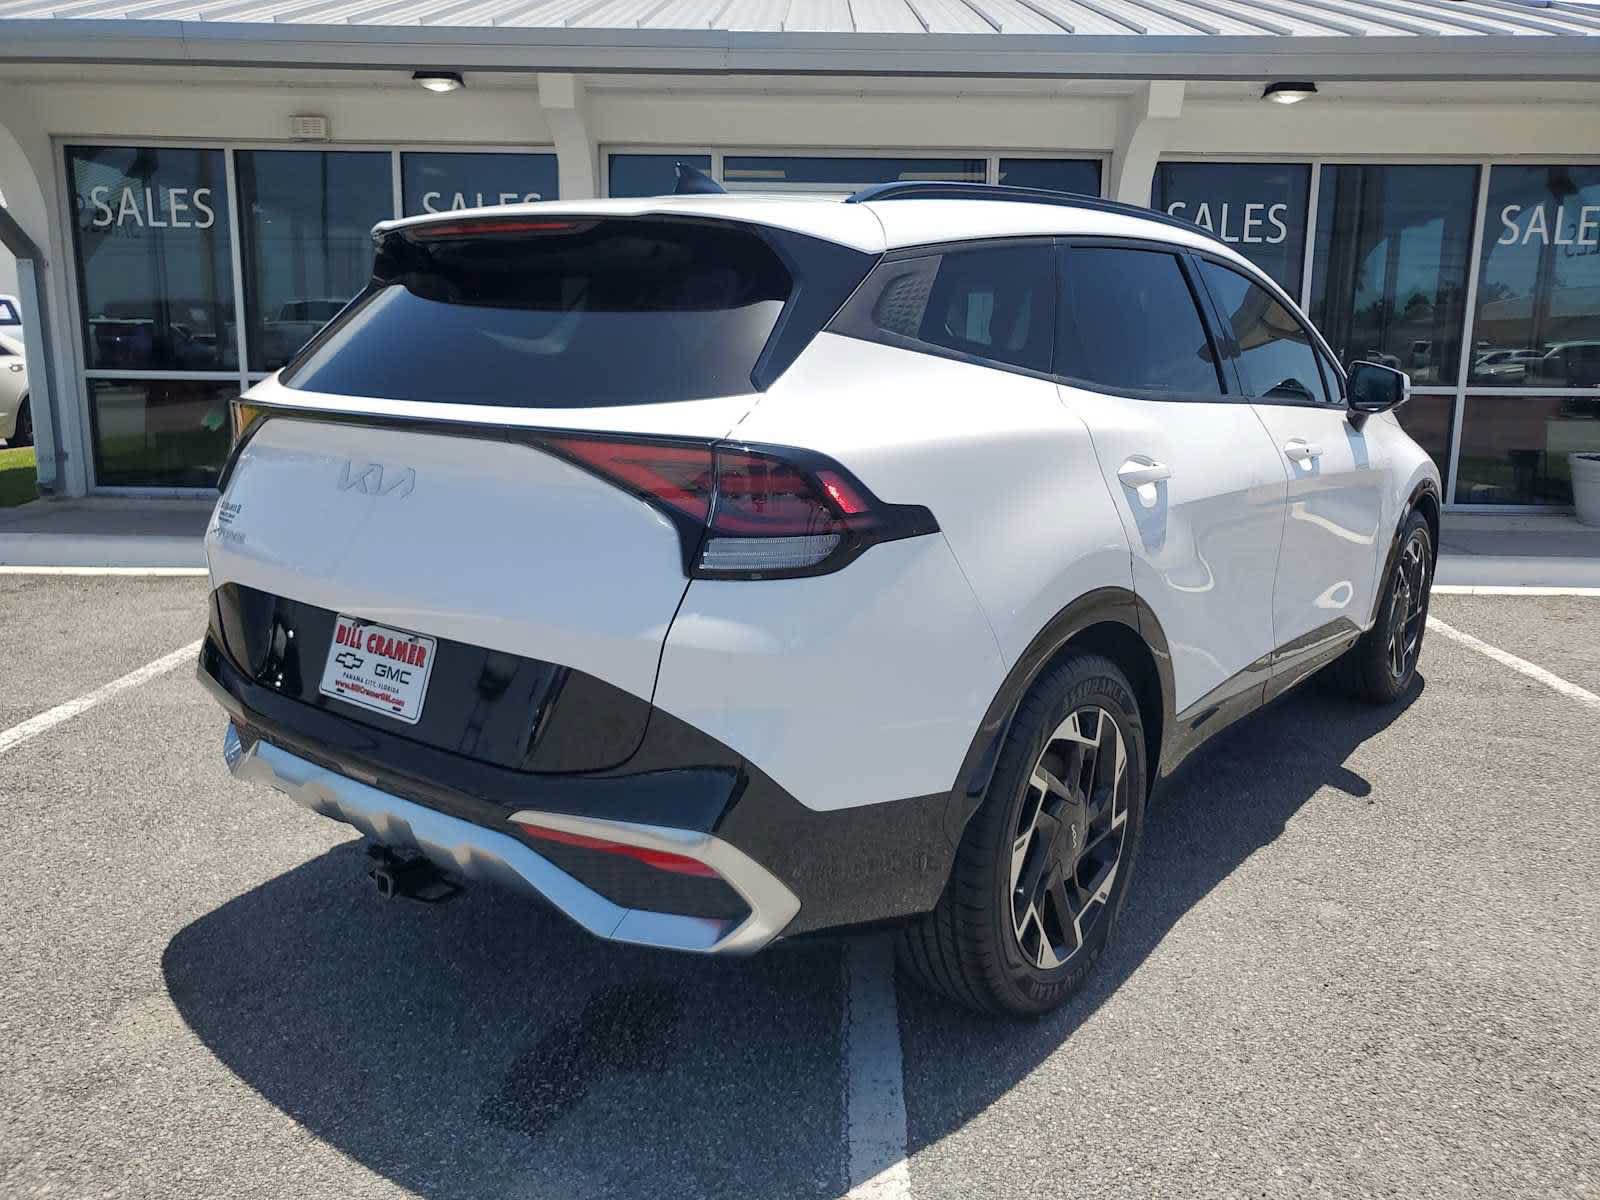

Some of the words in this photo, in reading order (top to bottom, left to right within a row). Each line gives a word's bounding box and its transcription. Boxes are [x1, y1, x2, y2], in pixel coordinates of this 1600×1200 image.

[90, 185, 215, 229] SALES
[335, 623, 363, 650] BILL
[366, 633, 427, 668] CRAMER
[342, 671, 364, 684] PANAMA
[378, 683, 400, 695] FLORIDA
[374, 664, 411, 685] GMC
